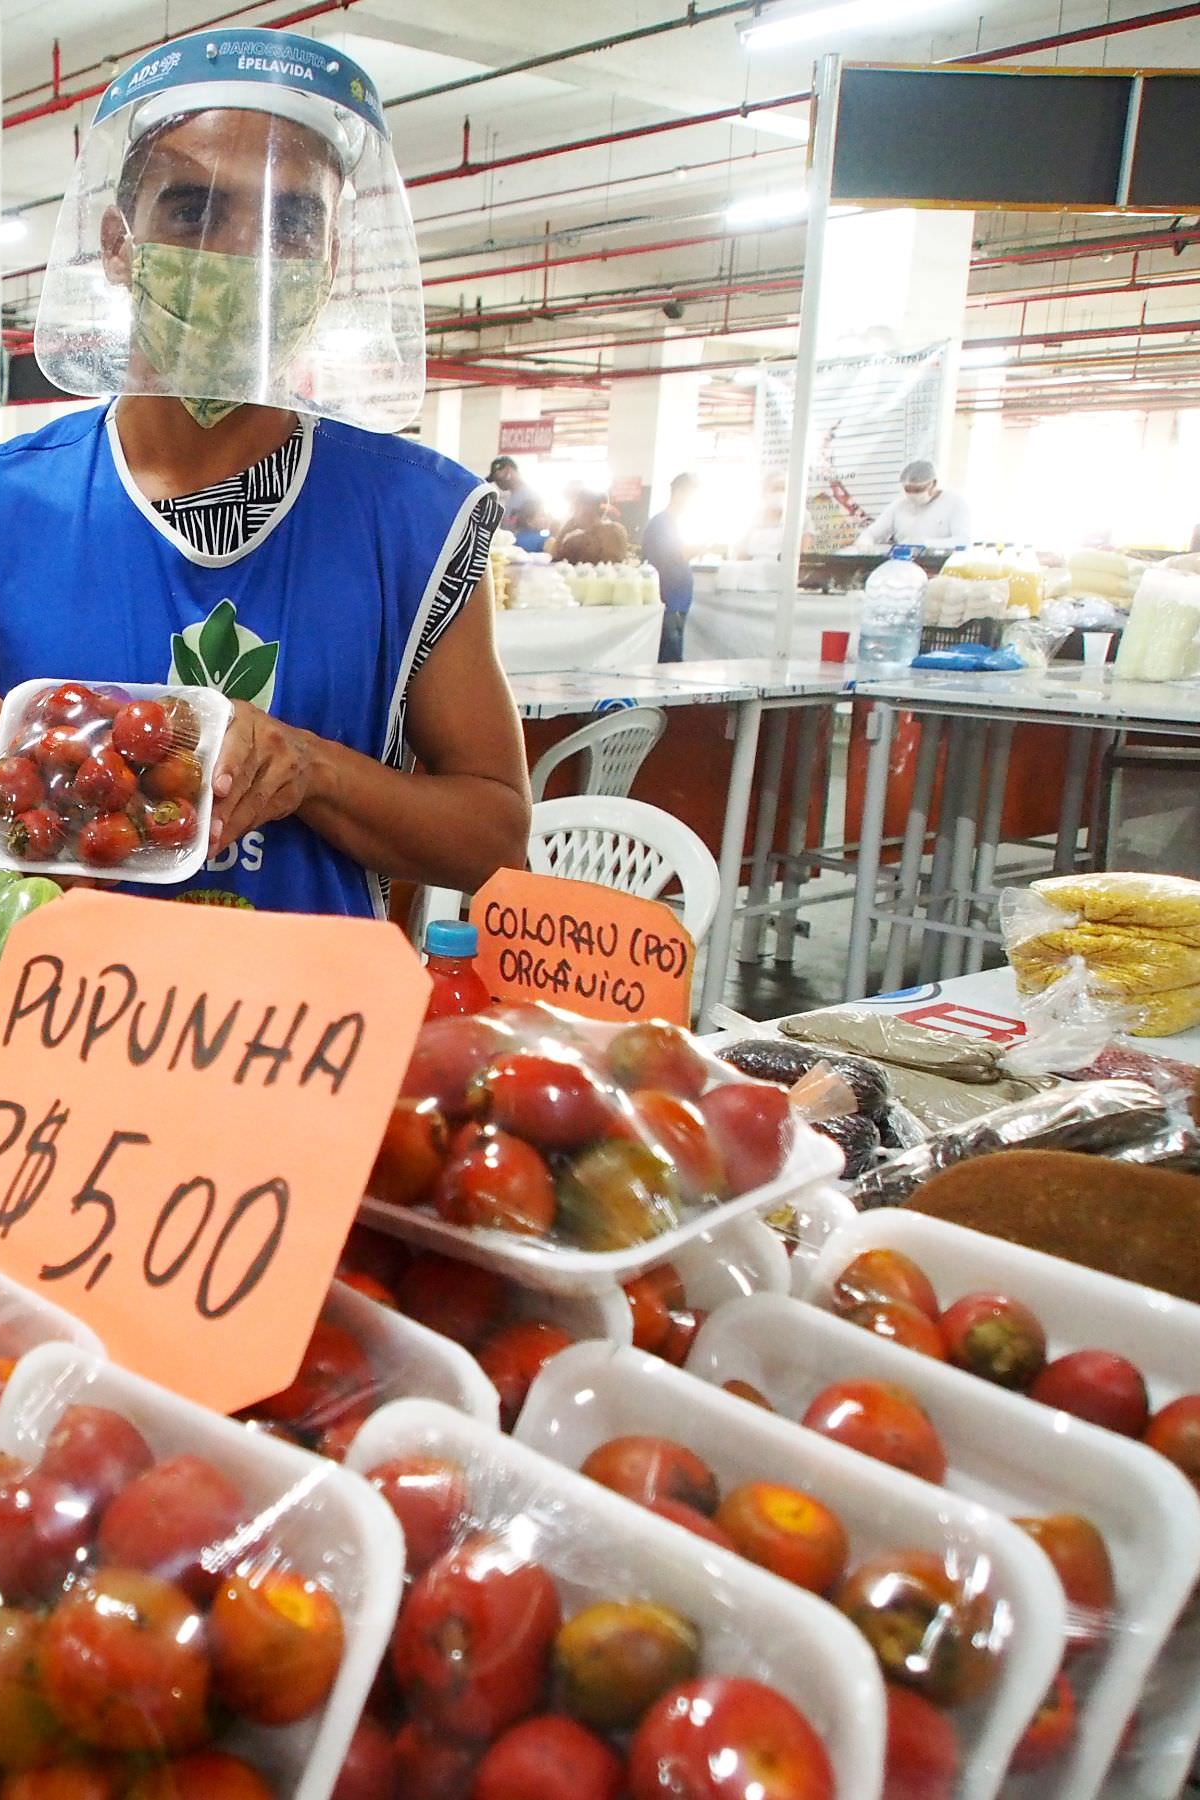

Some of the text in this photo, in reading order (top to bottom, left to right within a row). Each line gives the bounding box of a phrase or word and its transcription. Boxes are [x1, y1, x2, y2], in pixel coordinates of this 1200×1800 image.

[128, 60, 160, 88] ADS
[238, 55, 314, 81] ÉPELAVIDA
[200, 831, 265, 872] DS
[484, 901, 619, 957] COLORAU
[3, 954, 366, 1094] PUPUNHA
